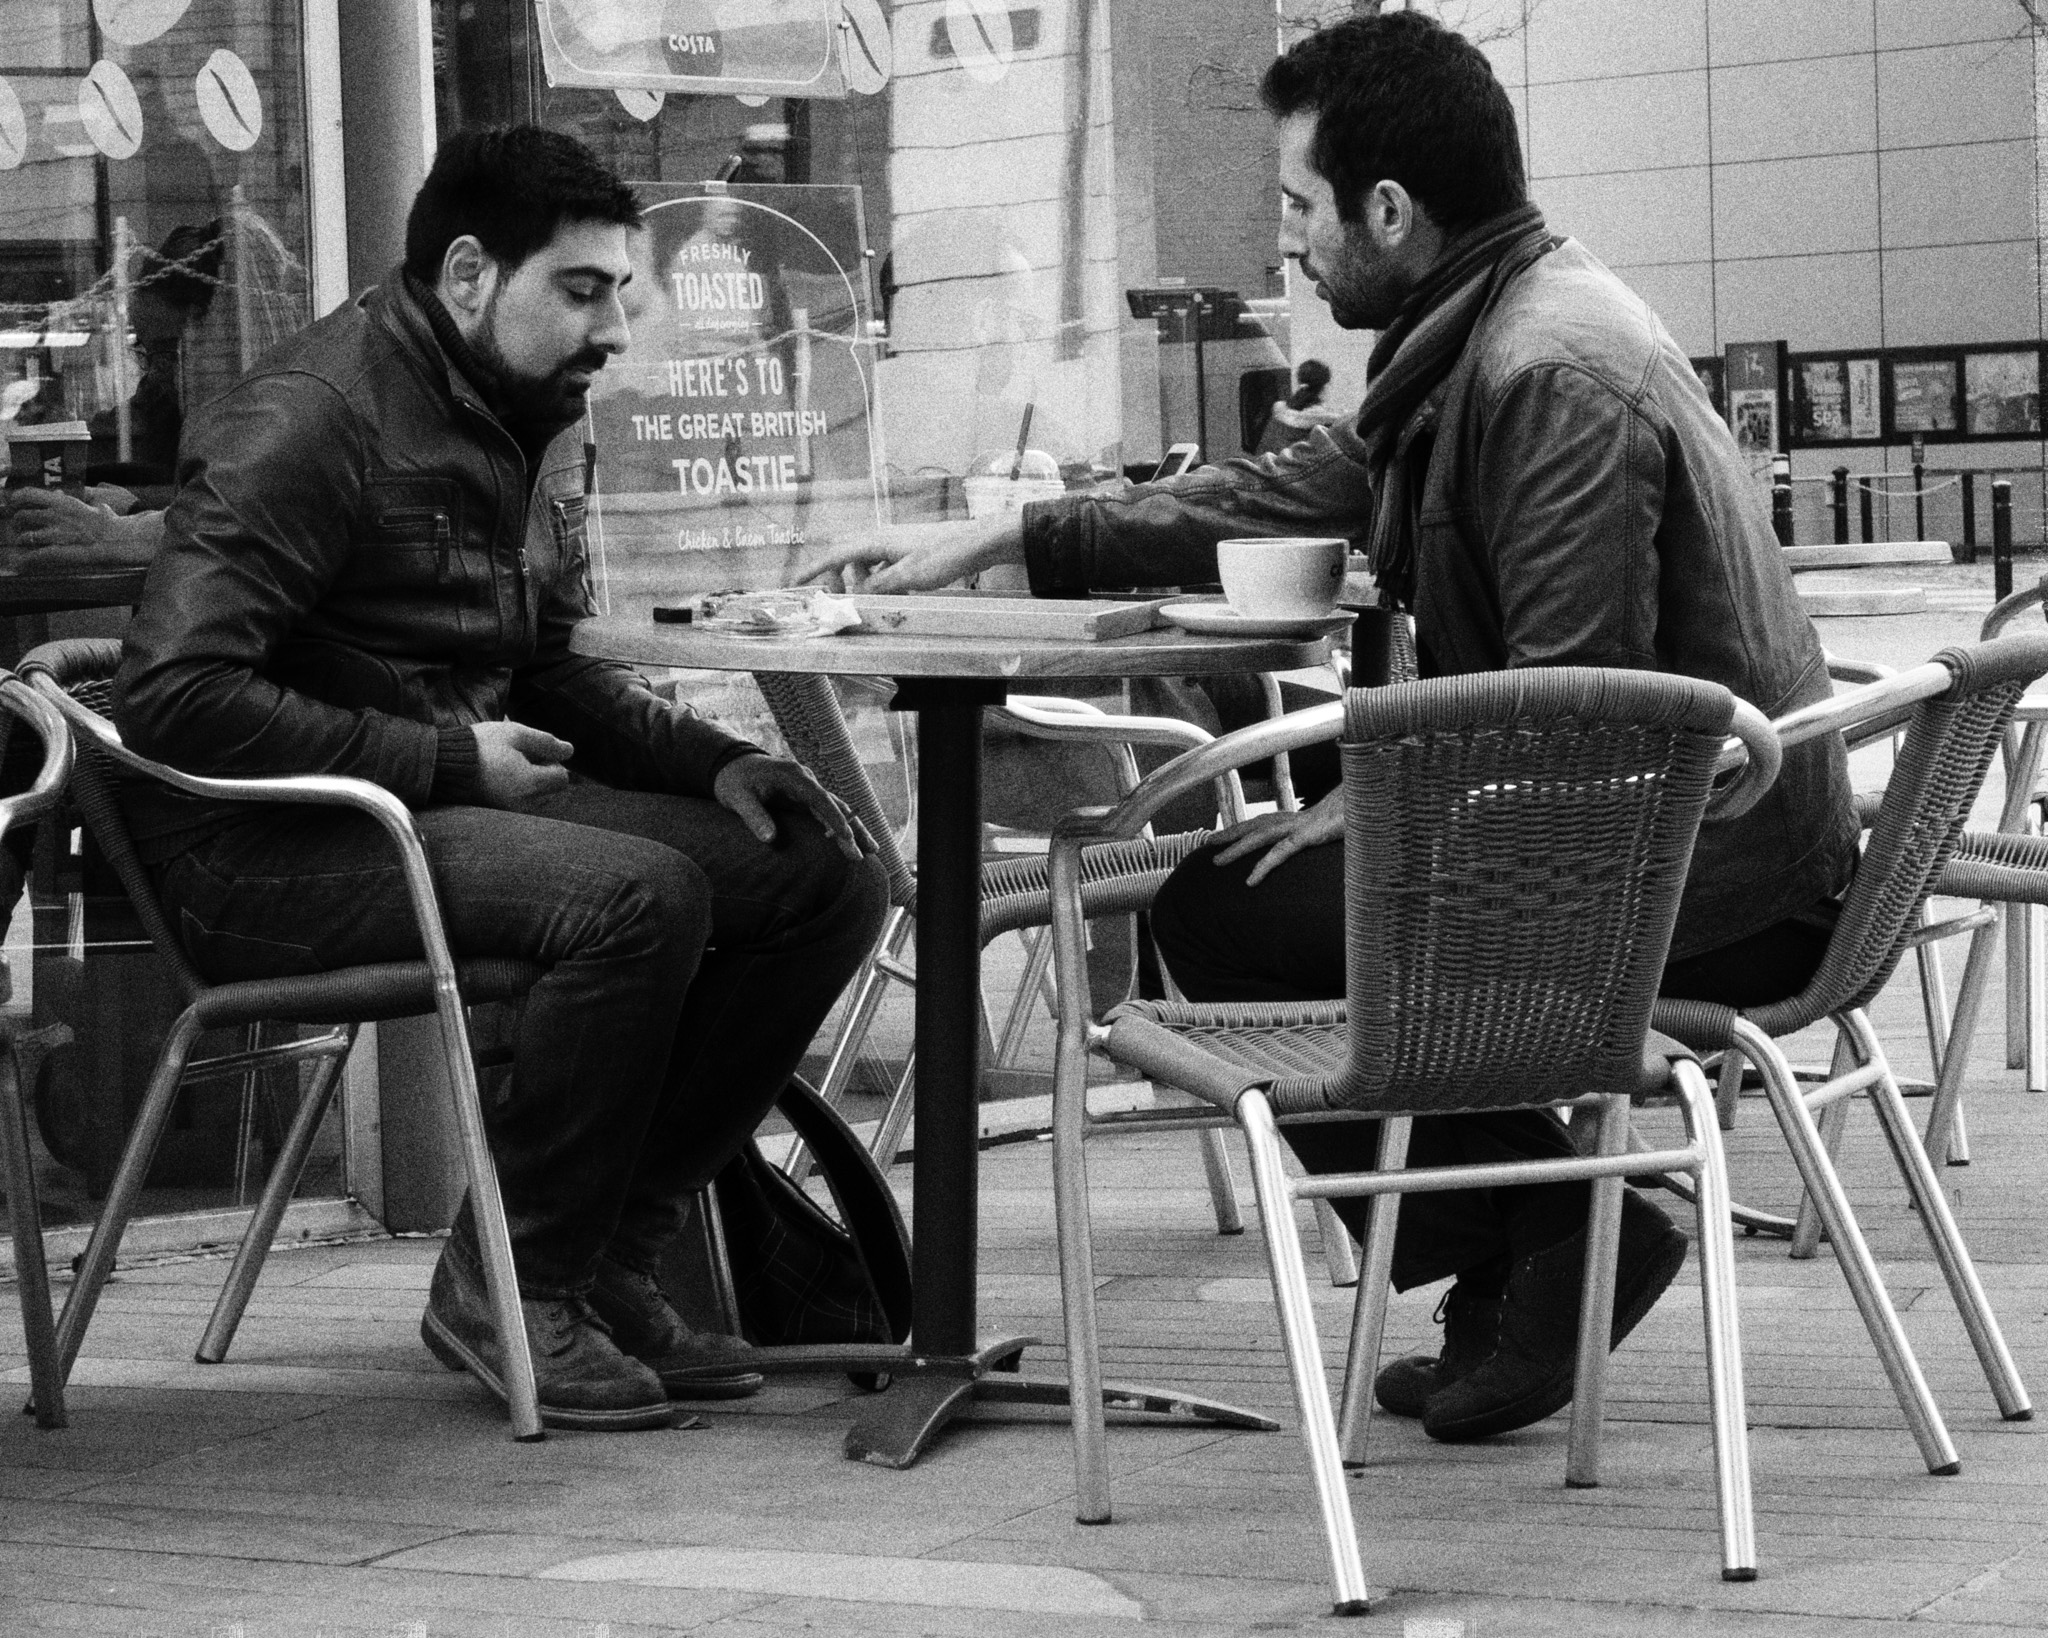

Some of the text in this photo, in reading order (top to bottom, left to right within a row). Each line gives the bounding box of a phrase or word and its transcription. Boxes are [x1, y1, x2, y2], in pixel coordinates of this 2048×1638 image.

[668, 33, 716, 54] COSTA
[679, 243, 751, 266] FRESHLY
[672, 272, 764, 310] TOASTED
[668, 357, 783, 397] HERE'S TO
[631, 410, 827, 441] THE GREAT BRITISH
[672, 455, 798, 496] TOASTIE
[678, 523, 806, 551] Chicken & Bacon Toastie
